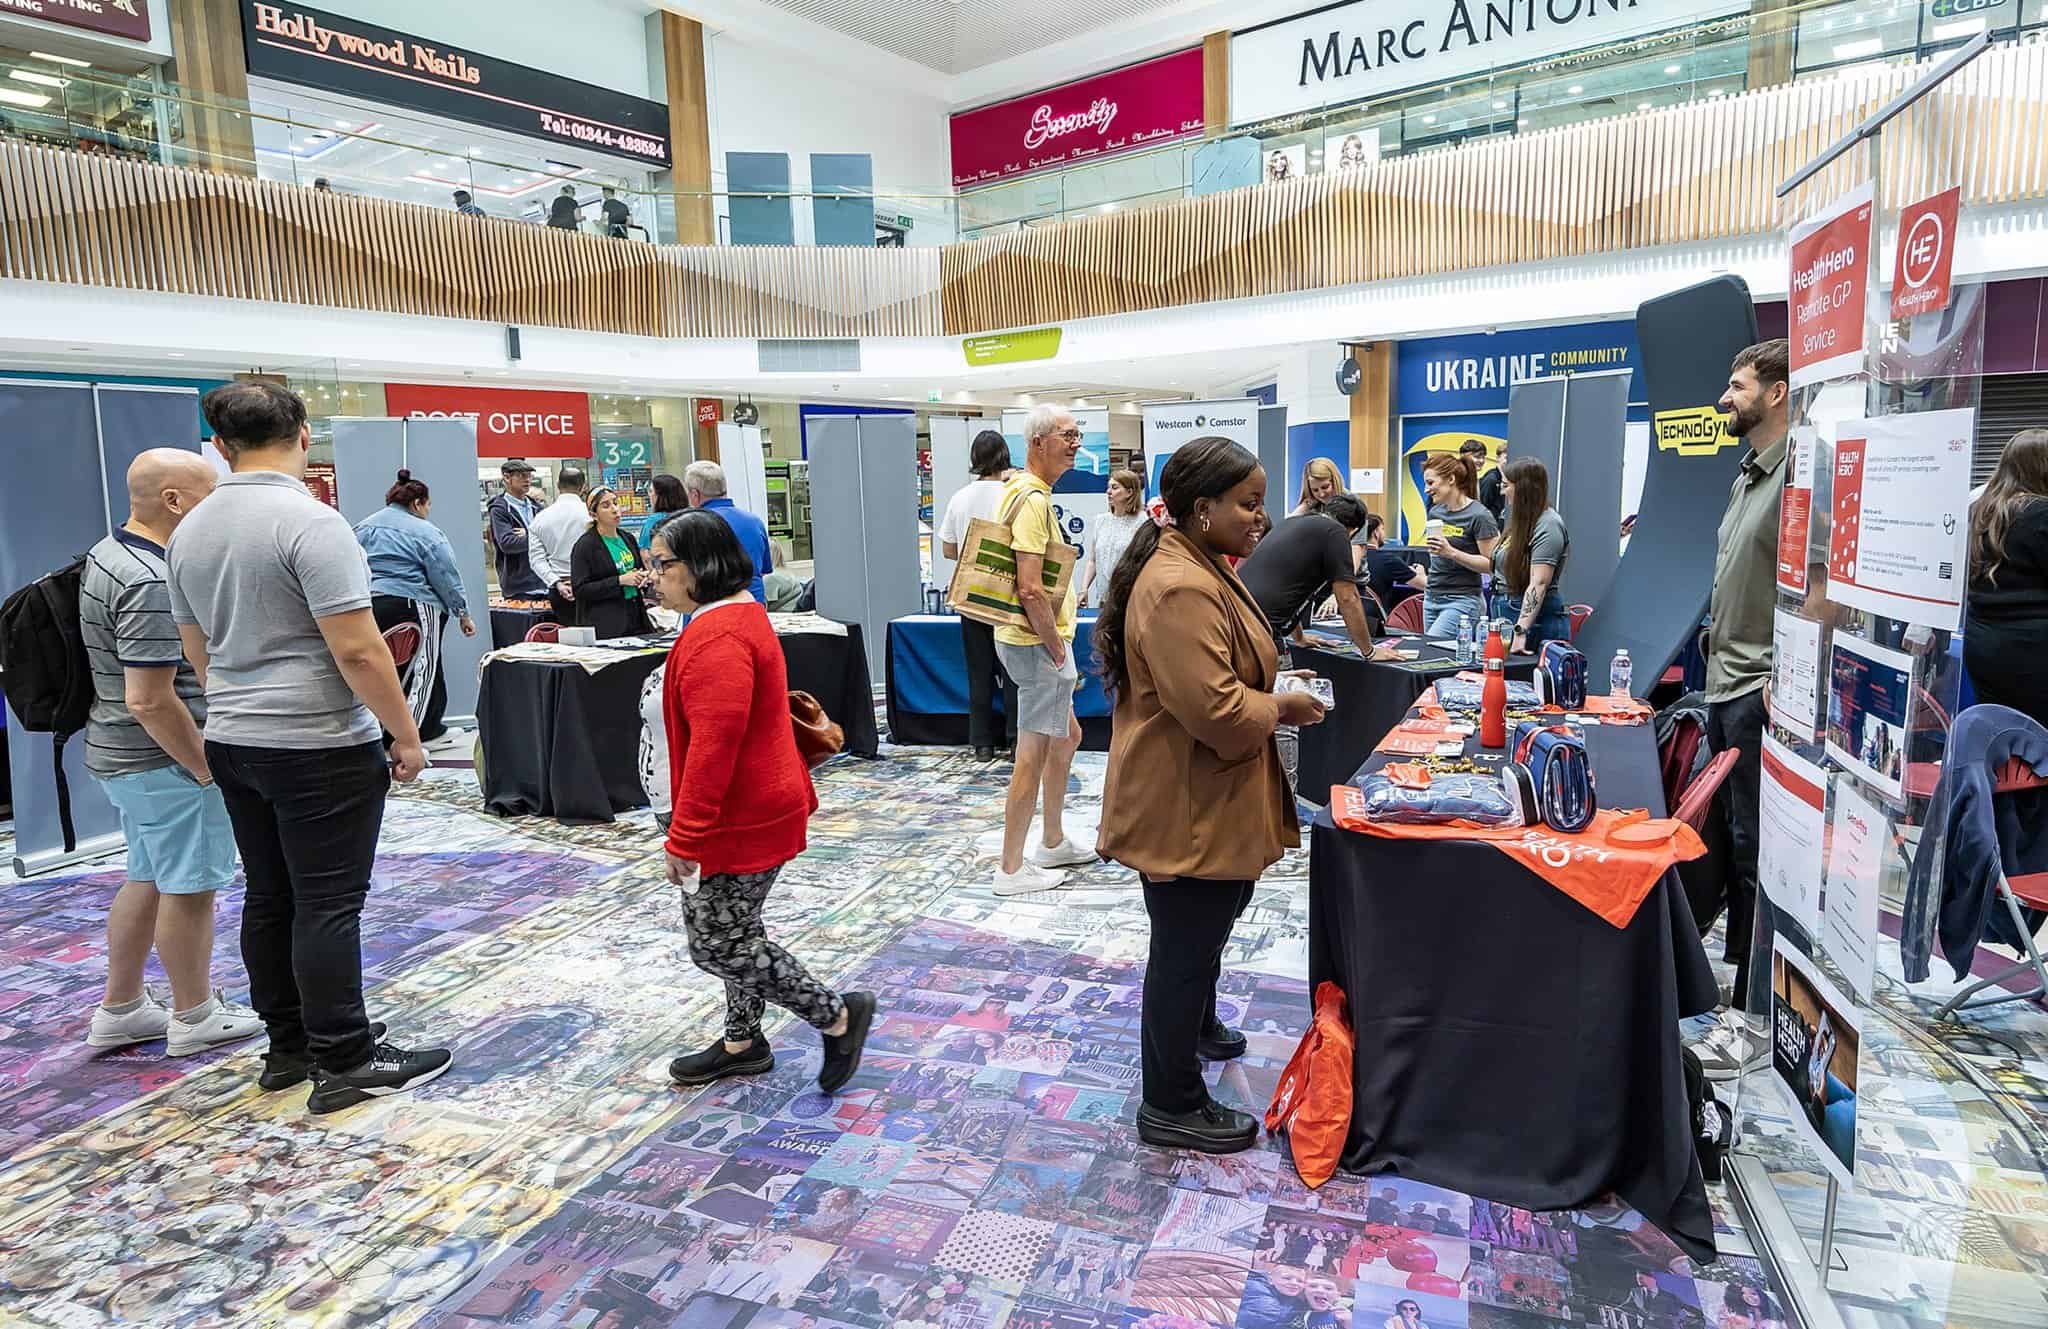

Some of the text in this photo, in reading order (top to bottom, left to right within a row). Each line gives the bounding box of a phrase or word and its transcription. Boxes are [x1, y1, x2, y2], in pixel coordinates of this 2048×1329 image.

[253, 2, 481, 84] Hollywood Nails
[1298, 20, 1427, 86] MARC
[1023, 97, 1119, 149] Serenity
[1792, 246, 1854, 293] HealthHero
[1797, 280, 1851, 326] Remote GP
[1801, 328, 1836, 356] Service
[1427, 346, 1628, 392] UKRAINE COMMUNITY
[488, 412, 575, 435] OFFICE
[1155, 417, 1247, 430] Westcon Comstor
[605, 442, 620, 465] 3
[630, 442, 646, 465] 2
[1777, 1007, 1806, 1054] HEALTH
[1777, 1026, 1800, 1063] HERO
